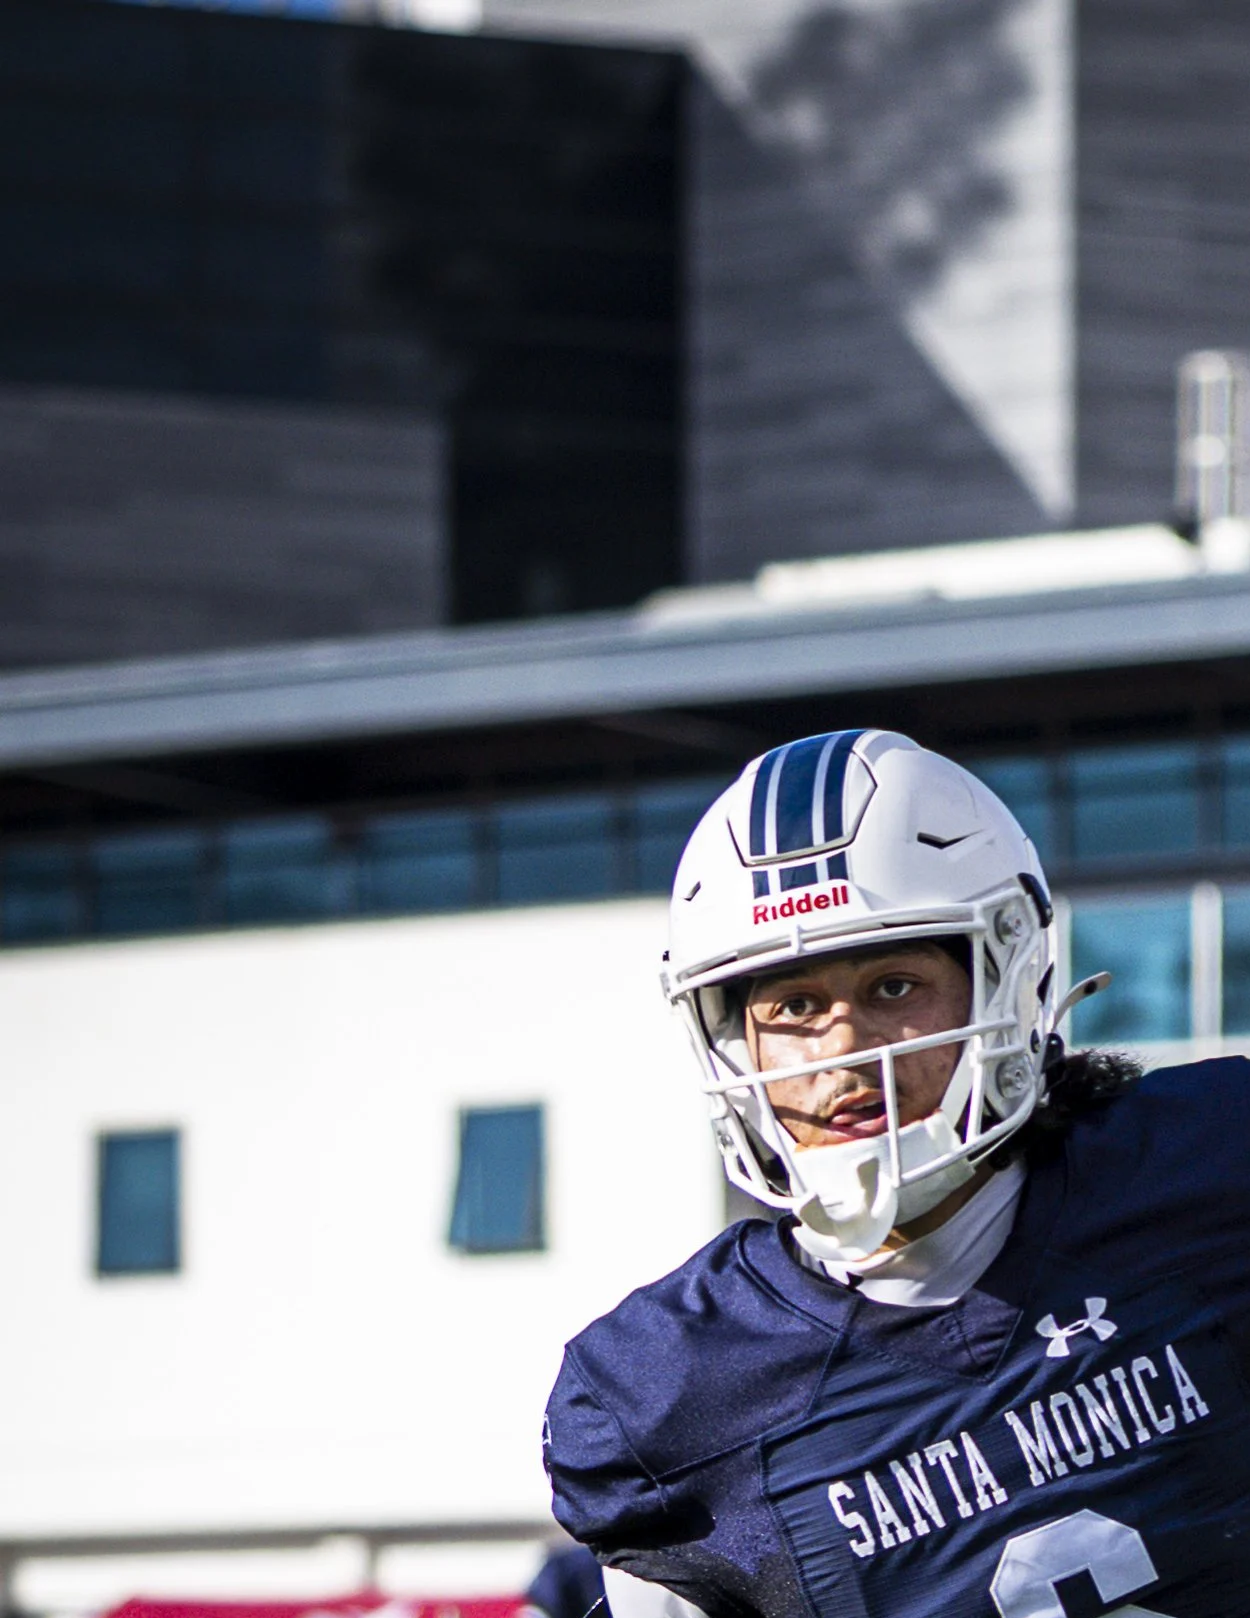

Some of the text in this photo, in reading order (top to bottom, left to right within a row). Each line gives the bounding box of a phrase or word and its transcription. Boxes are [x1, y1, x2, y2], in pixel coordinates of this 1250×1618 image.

[753, 885, 849, 925] Riddell
[828, 1344, 1210, 1558] SANTA MONICA
